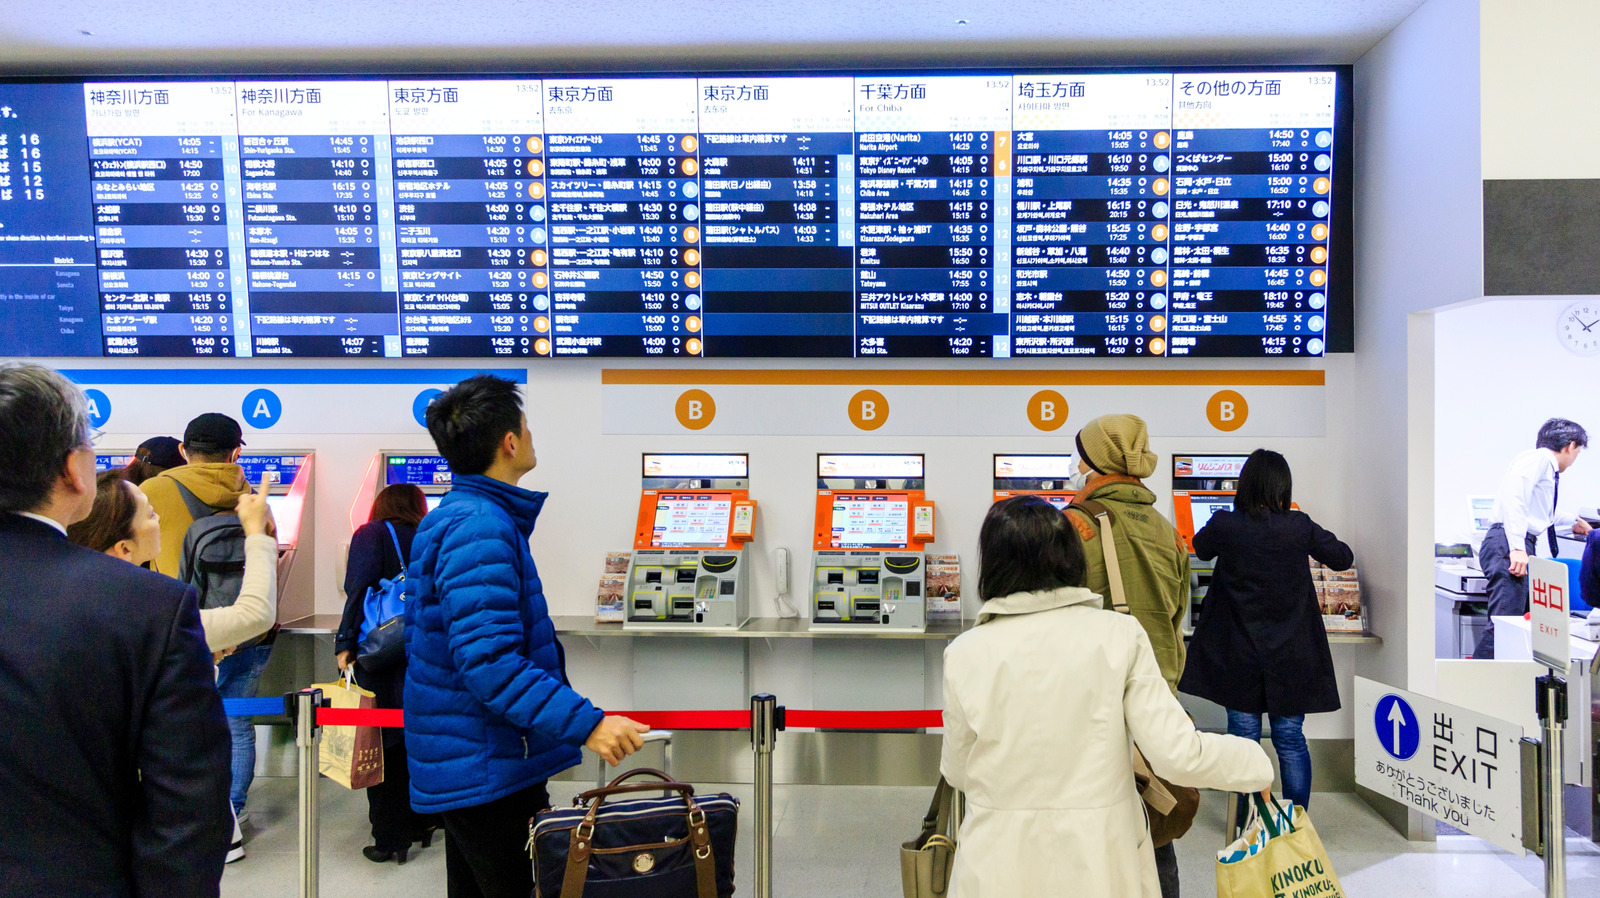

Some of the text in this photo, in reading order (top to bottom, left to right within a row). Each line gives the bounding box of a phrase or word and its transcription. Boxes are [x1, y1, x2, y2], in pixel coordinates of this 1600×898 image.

[704, 85, 769, 101] 東京方面
[860, 84, 926, 100] 千葉方面
[1018, 82, 1085, 98] 埼玉方面
[1180, 80, 1281, 96] その他の方面
[90, 89, 170, 105] 神奈川方面
[241, 88, 321, 104] 神奈川方面
[394, 88, 459, 103] 東京方面
[548, 86, 613, 102] 東京方面
[242, 108, 303, 118] For Kanagawa
[877, 104, 902, 112] Chiba
[20, 133, 40, 145] 16
[949, 133, 973, 142] 14:10
[999, 137, 1006, 147] 7
[1108, 132, 1132, 140] 14:05
[178, 138, 201, 146] 14:05
[860, 143, 898, 152] Narita Airport
[20, 148, 41, 159] 16
[1268, 154, 1293, 162] 15:00
[22, 161, 42, 173] 15
[860, 167, 877, 175] Tokyo
[878, 167, 896, 175] Disney
[23, 175, 43, 187] 12
[484, 182, 508, 190] 14:05
[638, 181, 662, 189] 14:15
[1107, 178, 1131, 187] 14:35
[1267, 177, 1292, 186] 15:00
[181, 183, 204, 191] 14:25
[793, 181, 816, 189] 13:58
[840, 185, 852, 194] 16
[24, 189, 44, 200] 15
[949, 202, 973, 211] 14:15
[1266, 200, 1291, 209] 17:10
[486, 227, 510, 235] 14:20
[793, 226, 817, 234] 14:03
[1106, 224, 1131, 232] 15:25
[1265, 223, 1290, 232] 14:40
[487, 249, 511, 257] 14:30
[1265, 247, 1289, 255] 16:35
[1105, 270, 1130, 278] 14:50
[188, 294, 212, 302] 14:15
[949, 293, 972, 301] 14:00
[1105, 293, 1130, 301] 15:20
[1263, 292, 1288, 300] 18:10
[190, 316, 213, 324] 14:20
[1262, 315, 1287, 323] 14:55
[1262, 337, 1287, 346] 14:15
[87, 398, 101, 418] A
[254, 398, 271, 418] A
[689, 400, 703, 419] B
[862, 400, 876, 420] B
[1041, 401, 1056, 421] B
[1221, 401, 1235, 421] B
[1532, 577, 1564, 612] 出口
[1539, 623, 1559, 637] EXIT
[1433, 744, 1498, 790] EXIT
[1376, 761, 1496, 822] ありがとうございました
[1397, 783, 1469, 827] Thank you
[1270, 857, 1324, 893] KINOKU
